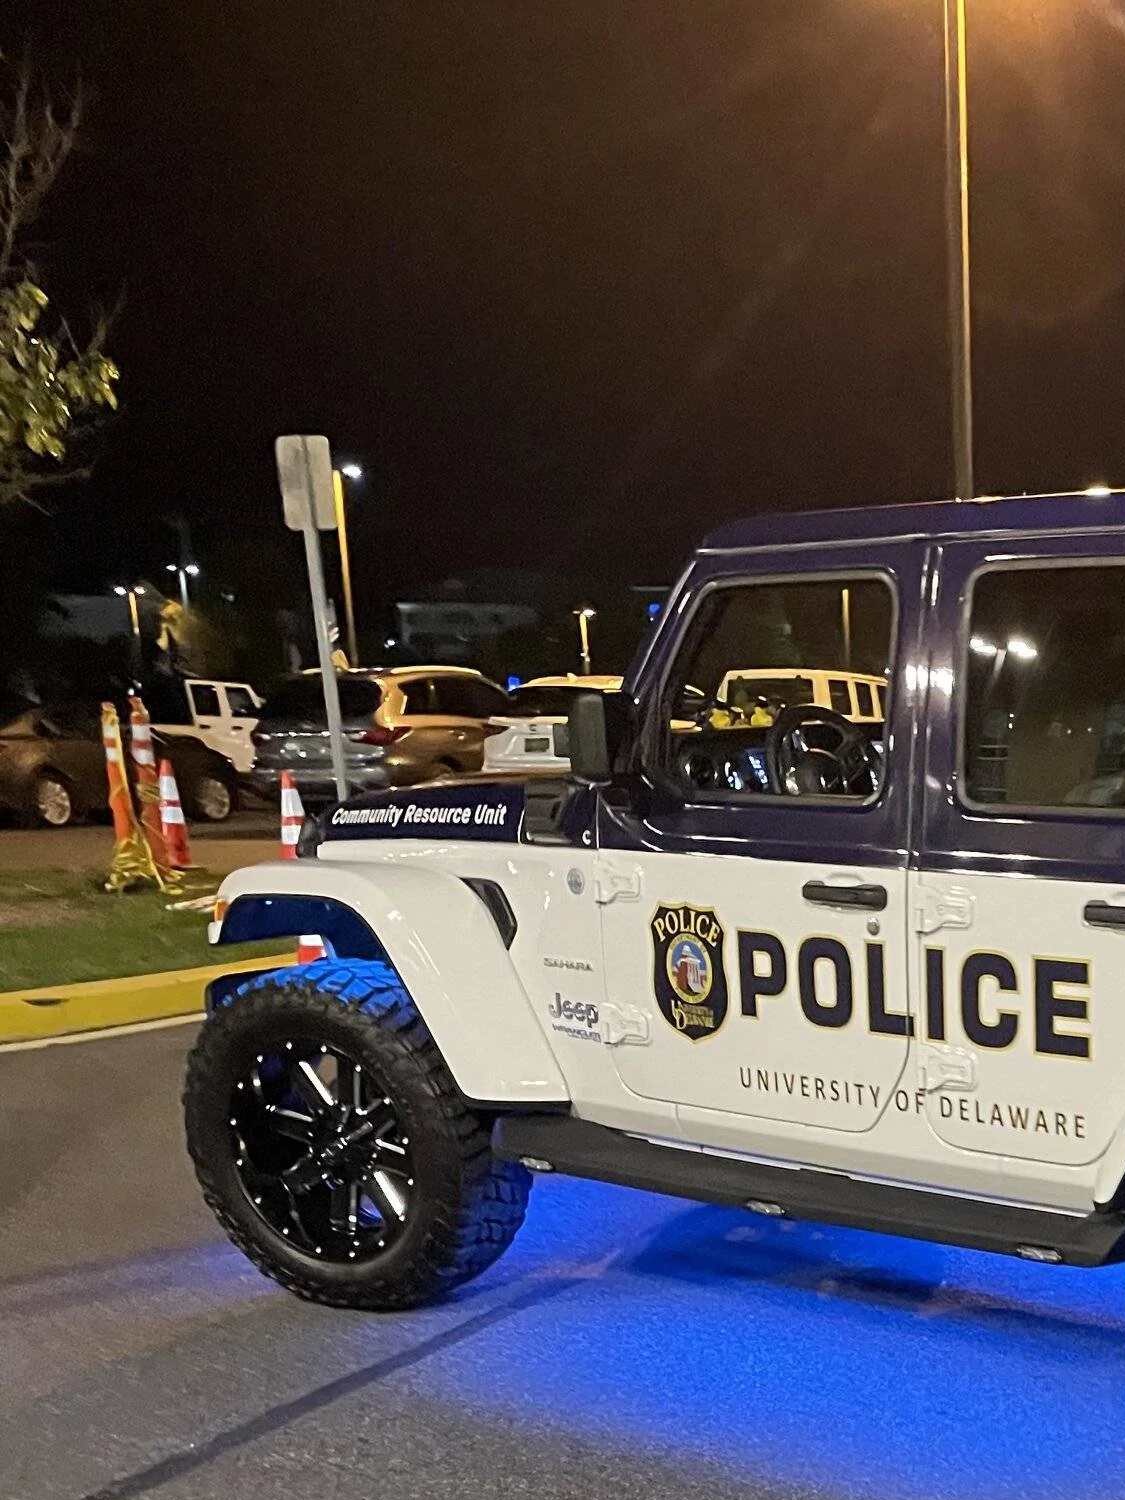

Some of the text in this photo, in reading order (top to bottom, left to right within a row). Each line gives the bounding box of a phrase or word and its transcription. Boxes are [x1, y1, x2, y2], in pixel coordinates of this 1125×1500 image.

[332, 804, 507, 827] Community Resource Unit
[653, 909, 720, 947] POLICE
[548, 992, 599, 1028] Jeep
[735, 927, 1094, 1062] POLICE
[739, 1066, 1086, 1139] UNIVERSITY OF DELAWARE
